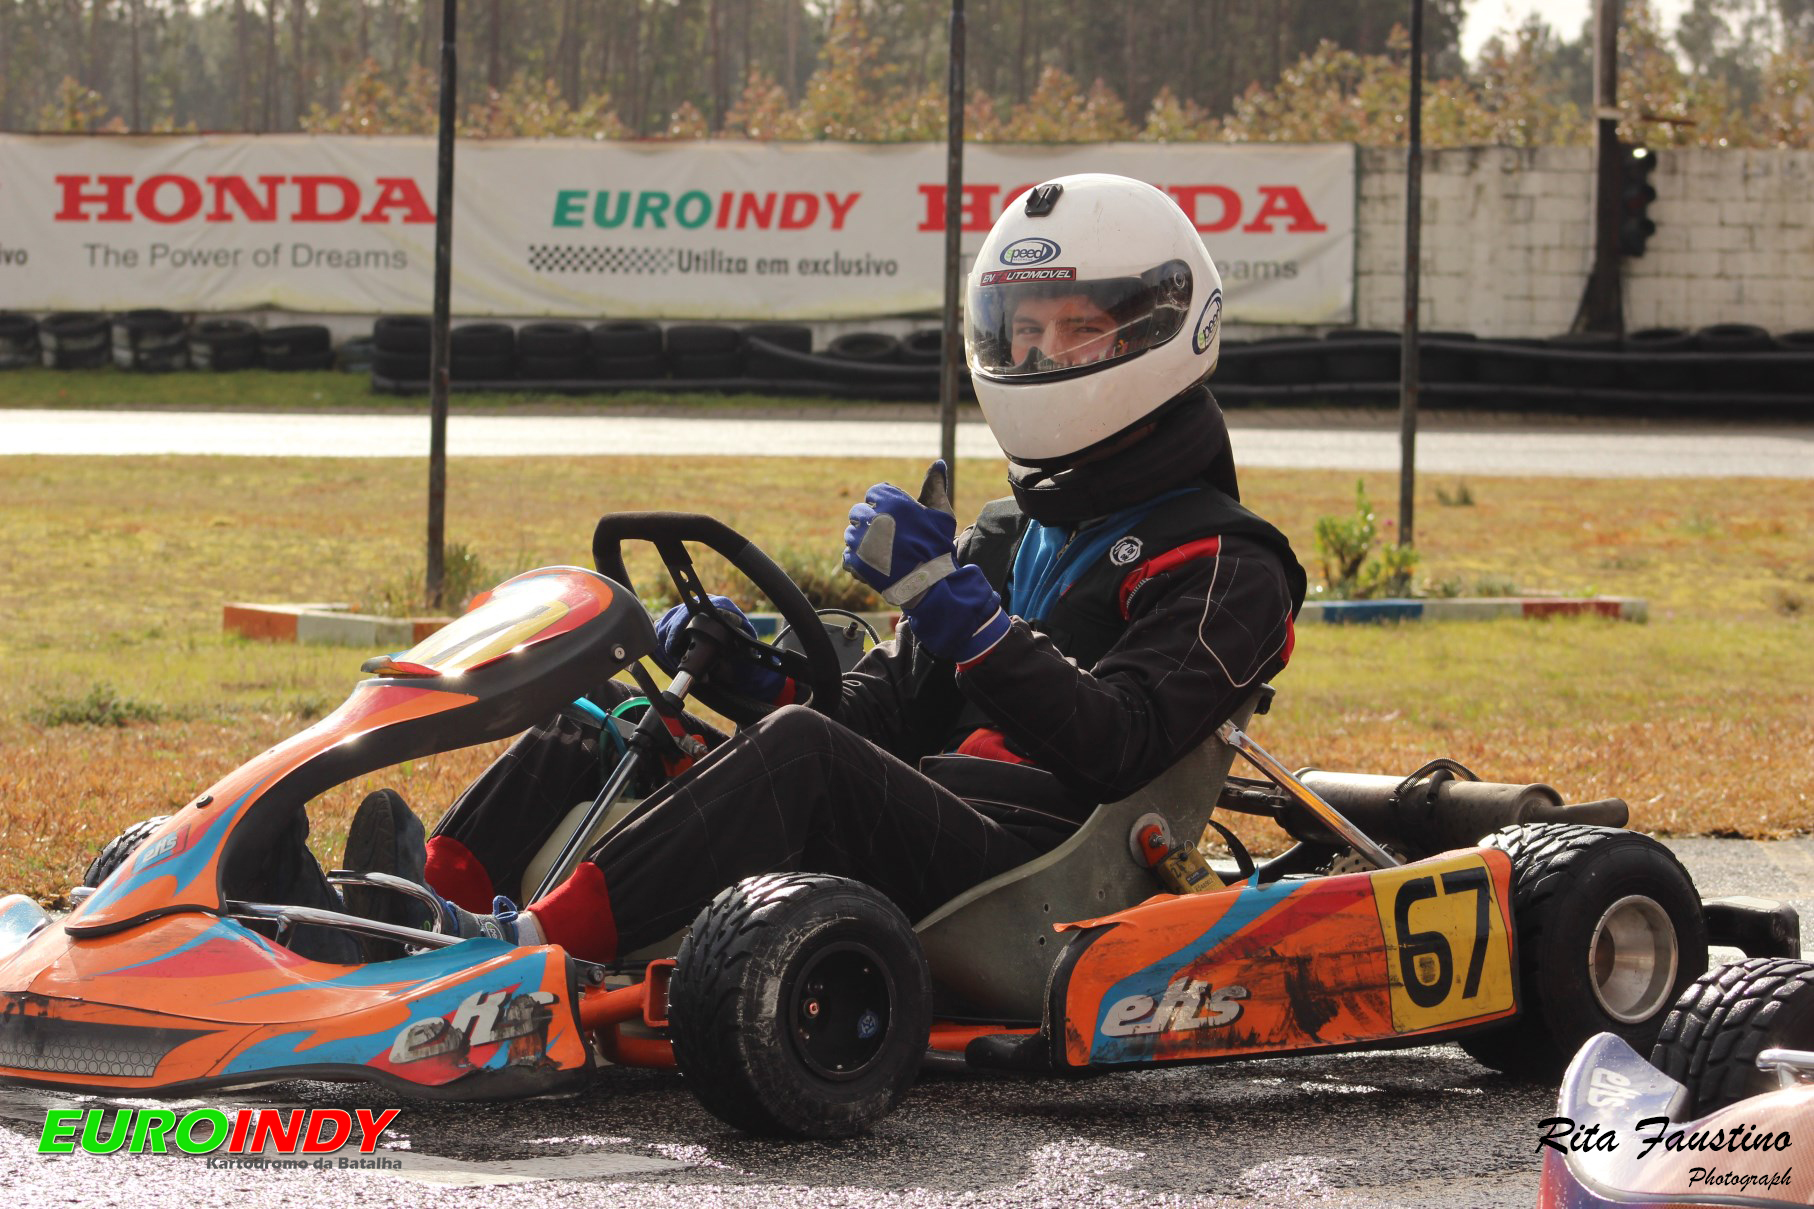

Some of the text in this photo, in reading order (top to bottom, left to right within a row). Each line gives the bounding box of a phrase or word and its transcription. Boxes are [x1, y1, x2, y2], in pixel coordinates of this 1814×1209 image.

[54, 174, 437, 225] HONDA
[551, 190, 861, 231] EUROINDY
[917, 183, 1328, 233] HDA
[84, 243, 408, 270] The Power of Dreams
[678, 249, 898, 277] Utiliza em exclusivo
[1394, 866, 1490, 1008] 67
